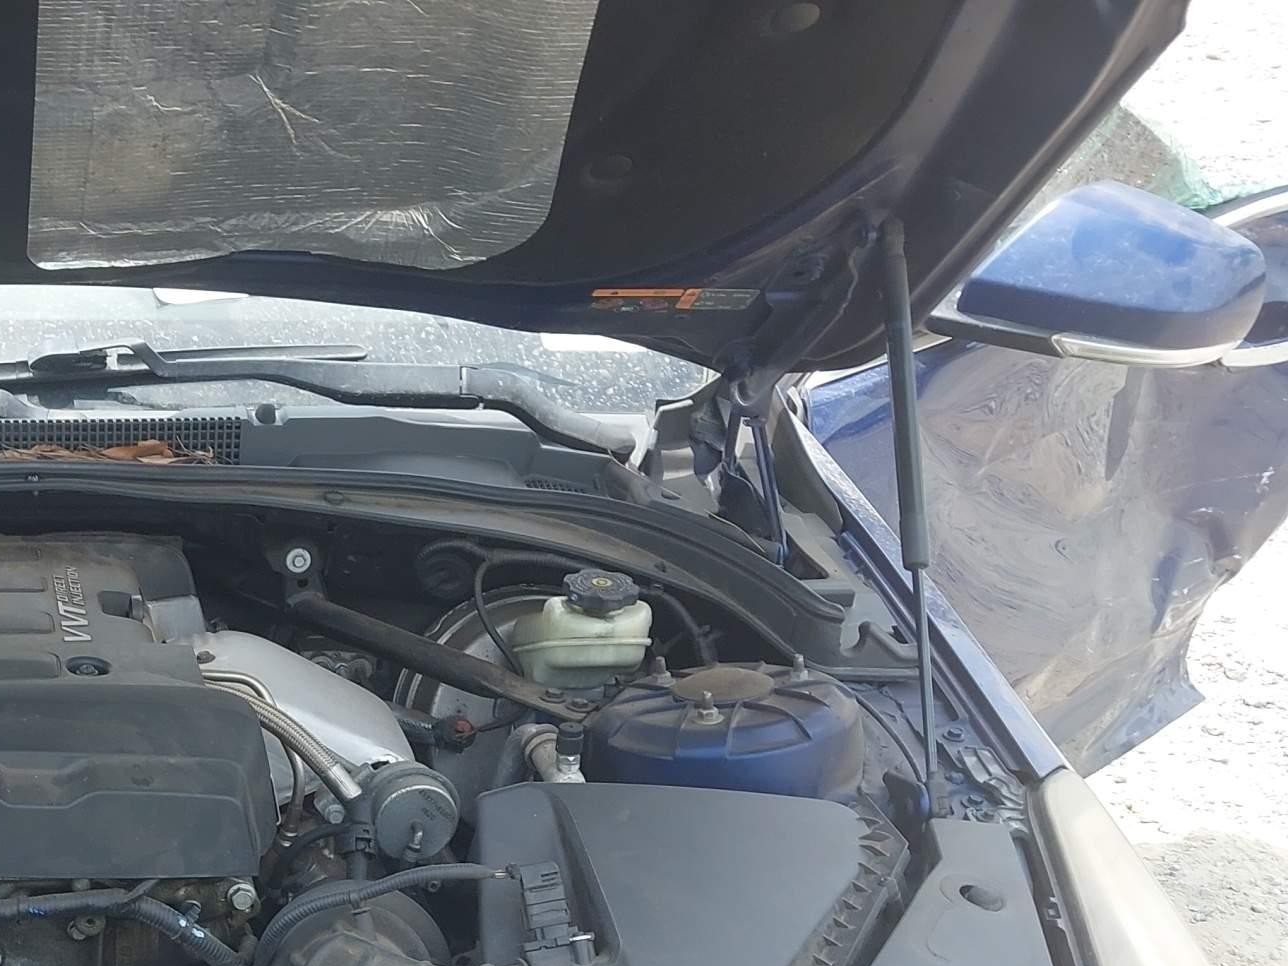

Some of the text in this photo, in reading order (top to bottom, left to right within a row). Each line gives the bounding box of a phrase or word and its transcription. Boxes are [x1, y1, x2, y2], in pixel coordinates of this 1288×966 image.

[53, 574, 69, 602] DIRECT
[65, 564, 86, 606] INJECTION
[57, 601, 92, 641] VVT
